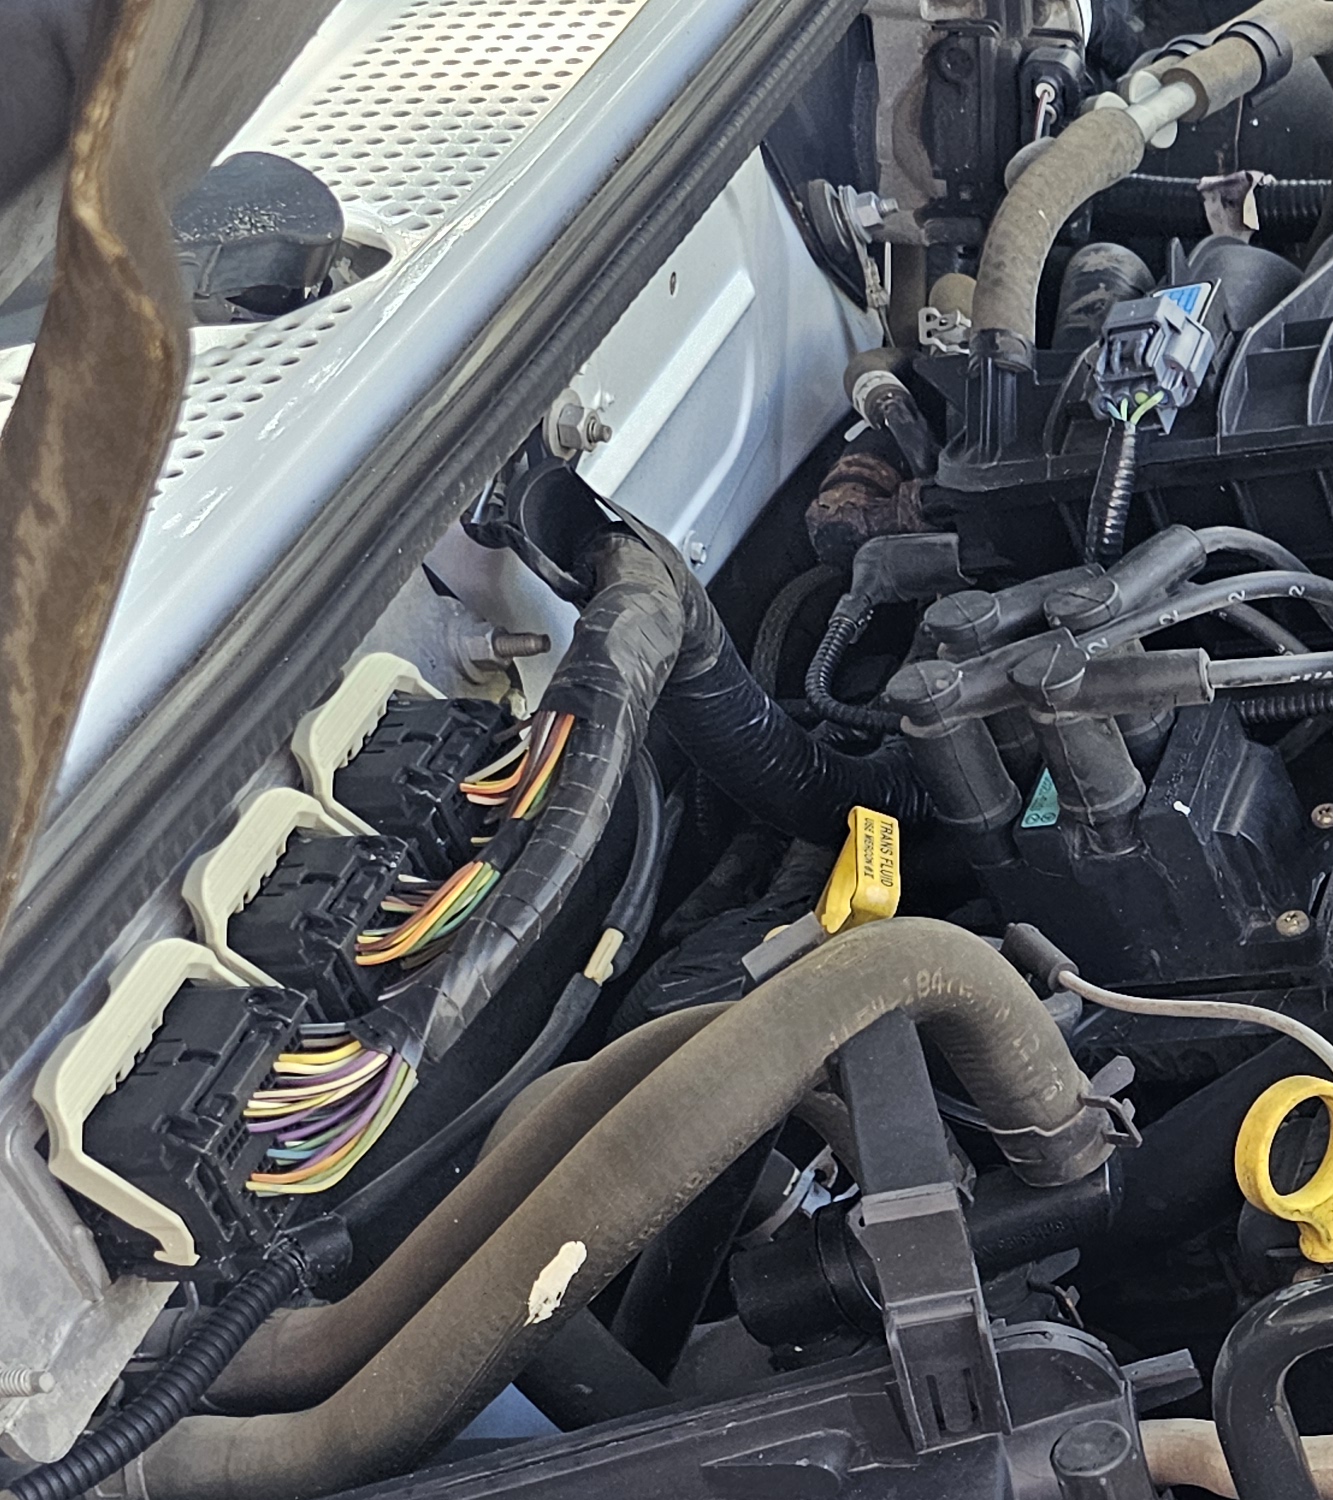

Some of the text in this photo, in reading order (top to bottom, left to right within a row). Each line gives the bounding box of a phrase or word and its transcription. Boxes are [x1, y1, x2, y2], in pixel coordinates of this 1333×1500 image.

[1159, 609, 1178, 626] 2
[1228, 589, 1246, 603] 2
[1290, 584, 1305, 597] 2
[879, 820, 893, 887] TRANS FLUID
